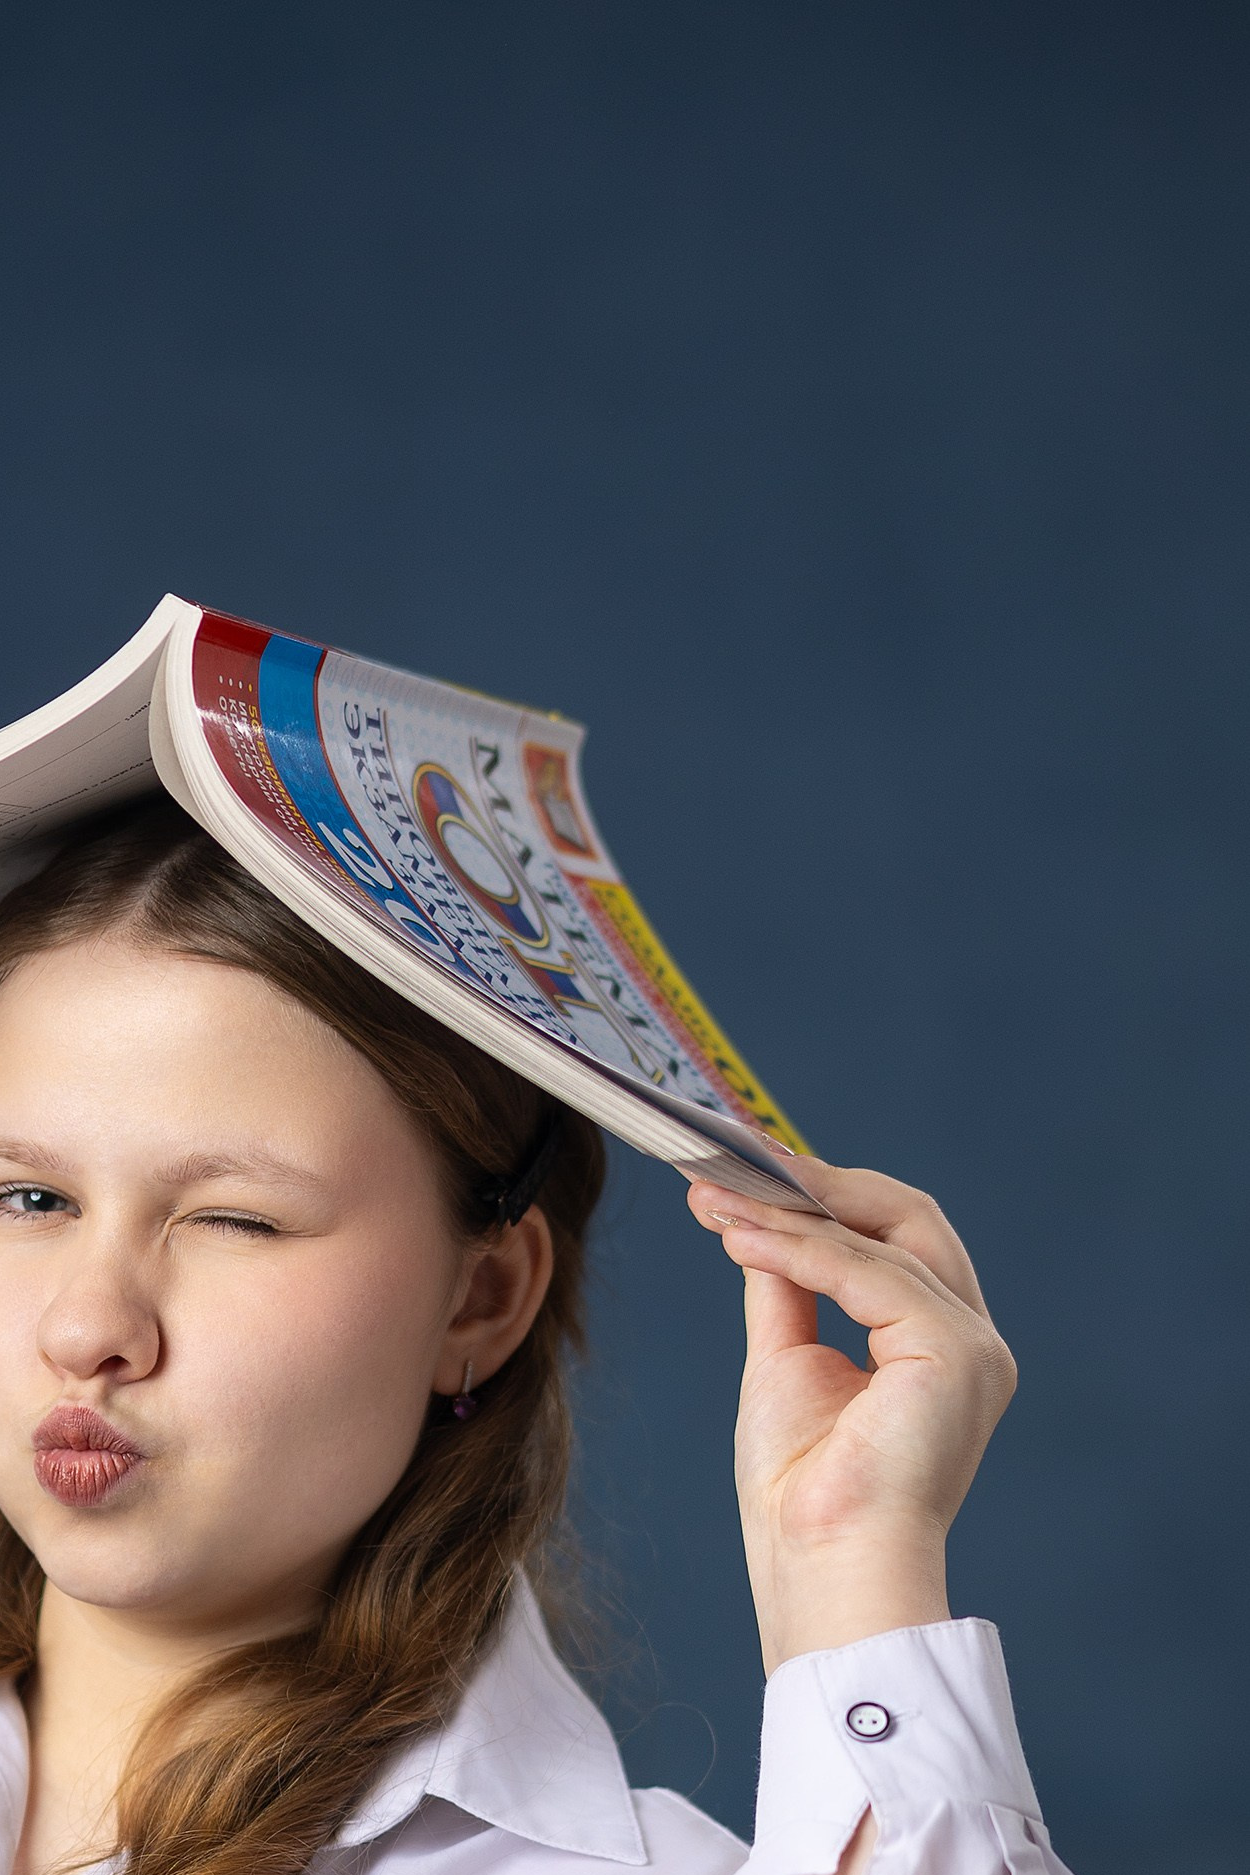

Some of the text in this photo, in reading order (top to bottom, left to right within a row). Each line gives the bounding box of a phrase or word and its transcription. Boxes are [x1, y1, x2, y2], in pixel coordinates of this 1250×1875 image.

[218, 695, 251, 778] Ответы
[238, 701, 299, 827] Интрукция
[316, 821, 472, 978] 20
[343, 701, 562, 1037] ЭКЗАМЕНАЦ
[365, 706, 578, 1046] ТИПОВЫЕ ВА
[387, 858, 536, 1021] ЗАДАН
[476, 742, 718, 1111] МАТЕМАТ
